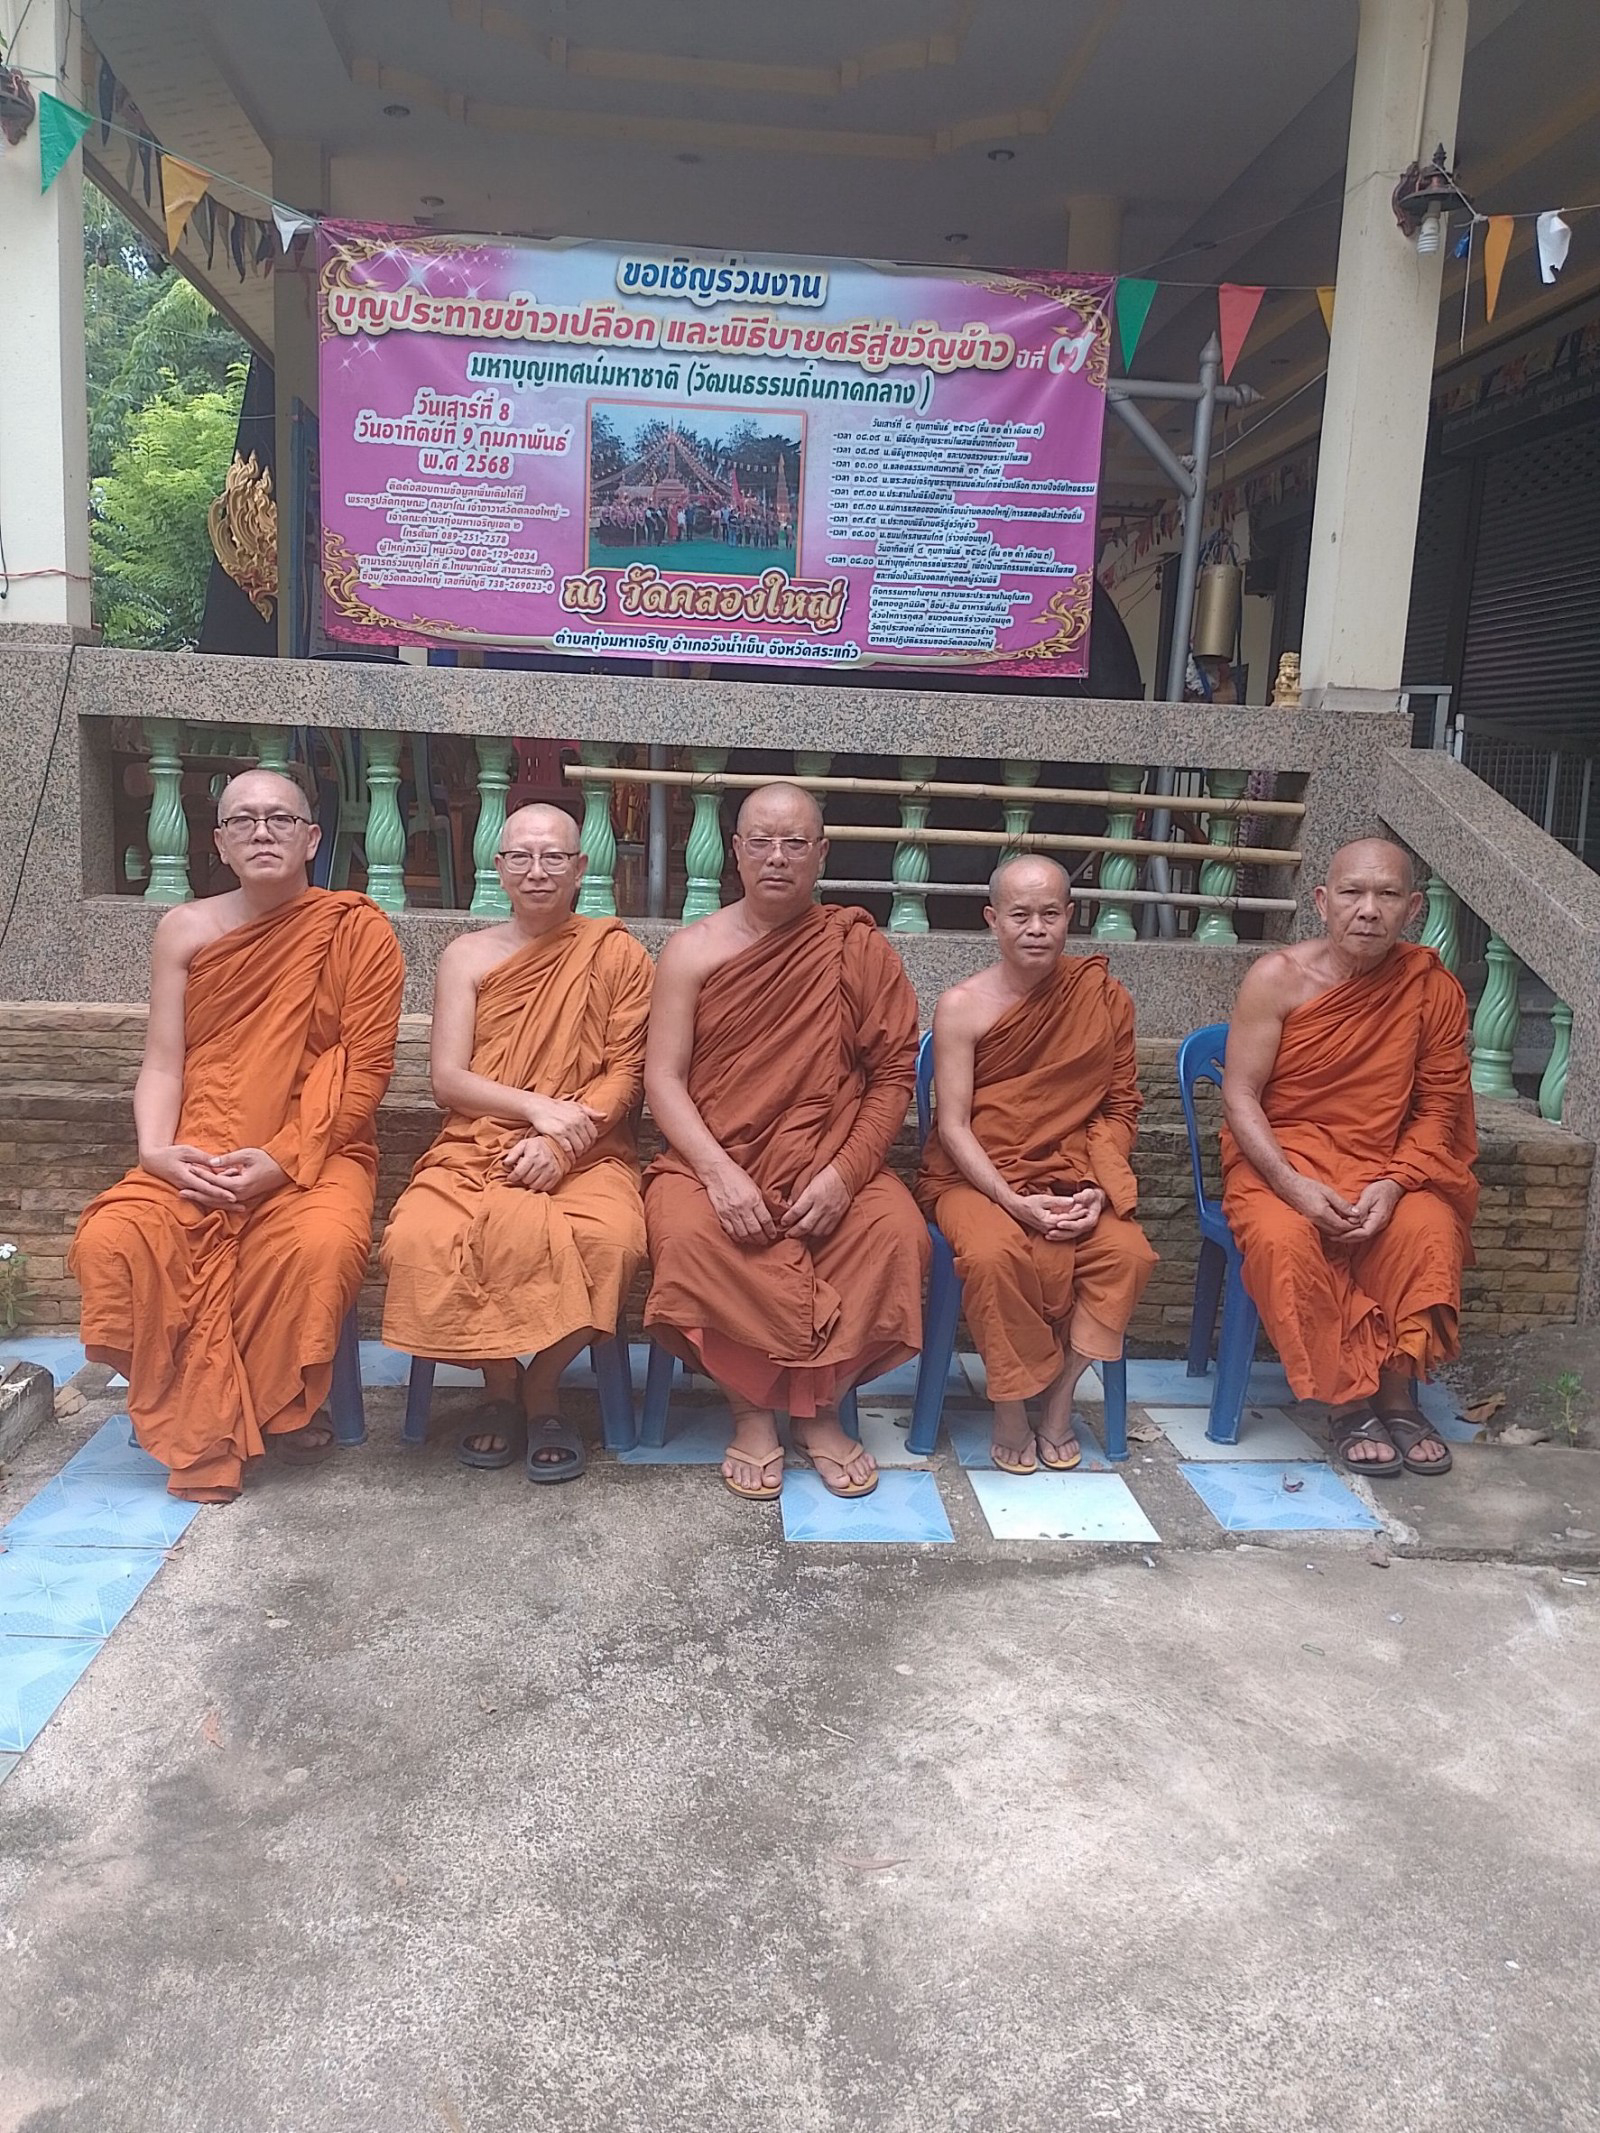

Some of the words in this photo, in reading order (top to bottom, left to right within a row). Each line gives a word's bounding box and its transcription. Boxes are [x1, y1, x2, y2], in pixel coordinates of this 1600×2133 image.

[622, 258, 821, 298] ขอเชิญร่วมงาน
[334, 294, 654, 341] บุญประทายข้าวเปลือก
[666, 317, 1008, 366] และพิธีบายศรีสู่ขวัญข้าว
[1016, 346, 1044, 369] ปีที่
[1049, 332, 1094, 374] ๗
[472, 353, 679, 387] มหาบุญเทศน์มหาชาติ
[418, 393, 493, 421] วันเสาร์ที่
[500, 403, 510, 421] 8
[359, 416, 457, 443] วันอาทิตย์ที่
[463, 428, 473, 444] 9
[480, 429, 570, 452] กุมภาพันธ์
[873, 418, 902, 428] วันเสาร์ที่
[916, 422, 950, 432] กุมภาพันธ์
[1014, 426, 1031, 434] เดือน
[466, 455, 510, 474] 2568
[389, 482, 523, 499] ติดต่อสอบถามข้อมูลเพิ่มเติมได้ที่
[468, 503, 560, 517] เจ้าอาวาสวัดคลองใหญ่
[403, 528, 438, 538] โทรศัพท์
[441, 532, 506, 544] 089-251-7578
[471, 549, 535, 560] 080-129-0034
[1026, 549, 1042, 559] เดือน
[360, 557, 440, 571] สามารถร่วมบุญได้ที่
[442, 561, 499, 573] ธ.ไทยพาณิชย์
[501, 566, 551, 576] สาขาสระแก้ว
[444, 576, 485, 588] เลขที่บัญชี
[564, 578, 602, 608] ณ
[620, 566, 847, 631] วัดคลองใหญ่
[555, 632, 668, 652] ตำบลทุ่งมหาเจริญ
[672, 635, 764, 654] อำเภอวังน้ำเย็น
[769, 642, 858, 659] จังหวัดสระแก้ว
